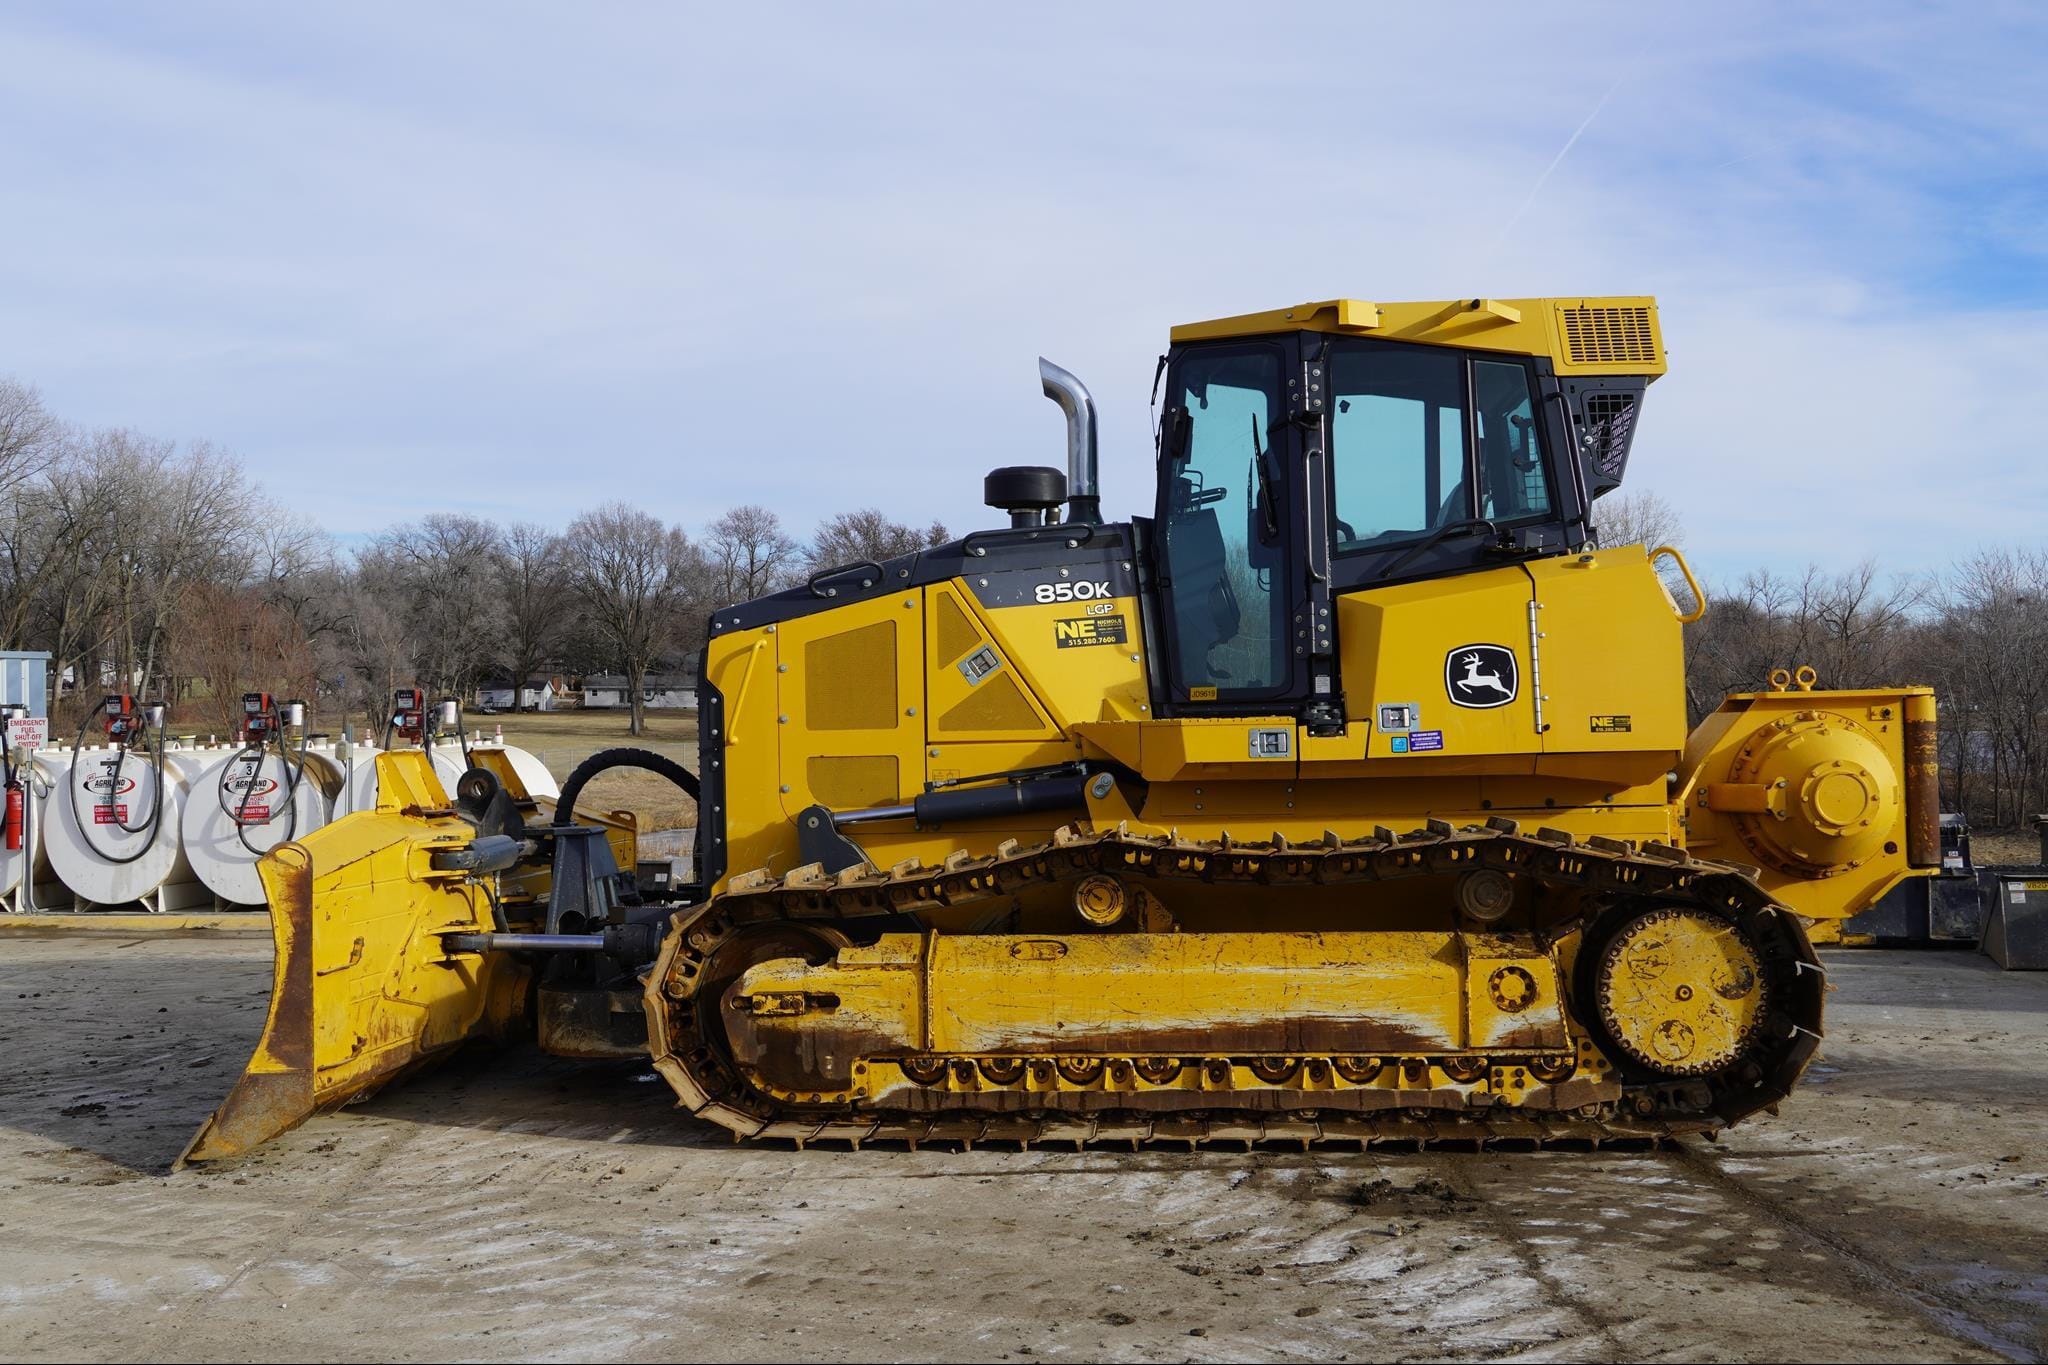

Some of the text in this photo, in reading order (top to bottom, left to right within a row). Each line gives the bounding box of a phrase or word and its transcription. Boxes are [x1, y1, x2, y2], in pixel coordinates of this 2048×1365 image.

[1035, 581, 1112, 603] 850K
[1086, 604, 1114, 615] LGP
[1057, 620, 1096, 639] NE
[1068, 636, 1116, 646] 515.280.7600
[1591, 717, 1614, 727] NE
[106, 765, 113, 776] 2
[246, 766, 253, 775] 3
[94, 779, 126, 787] AGRILND
